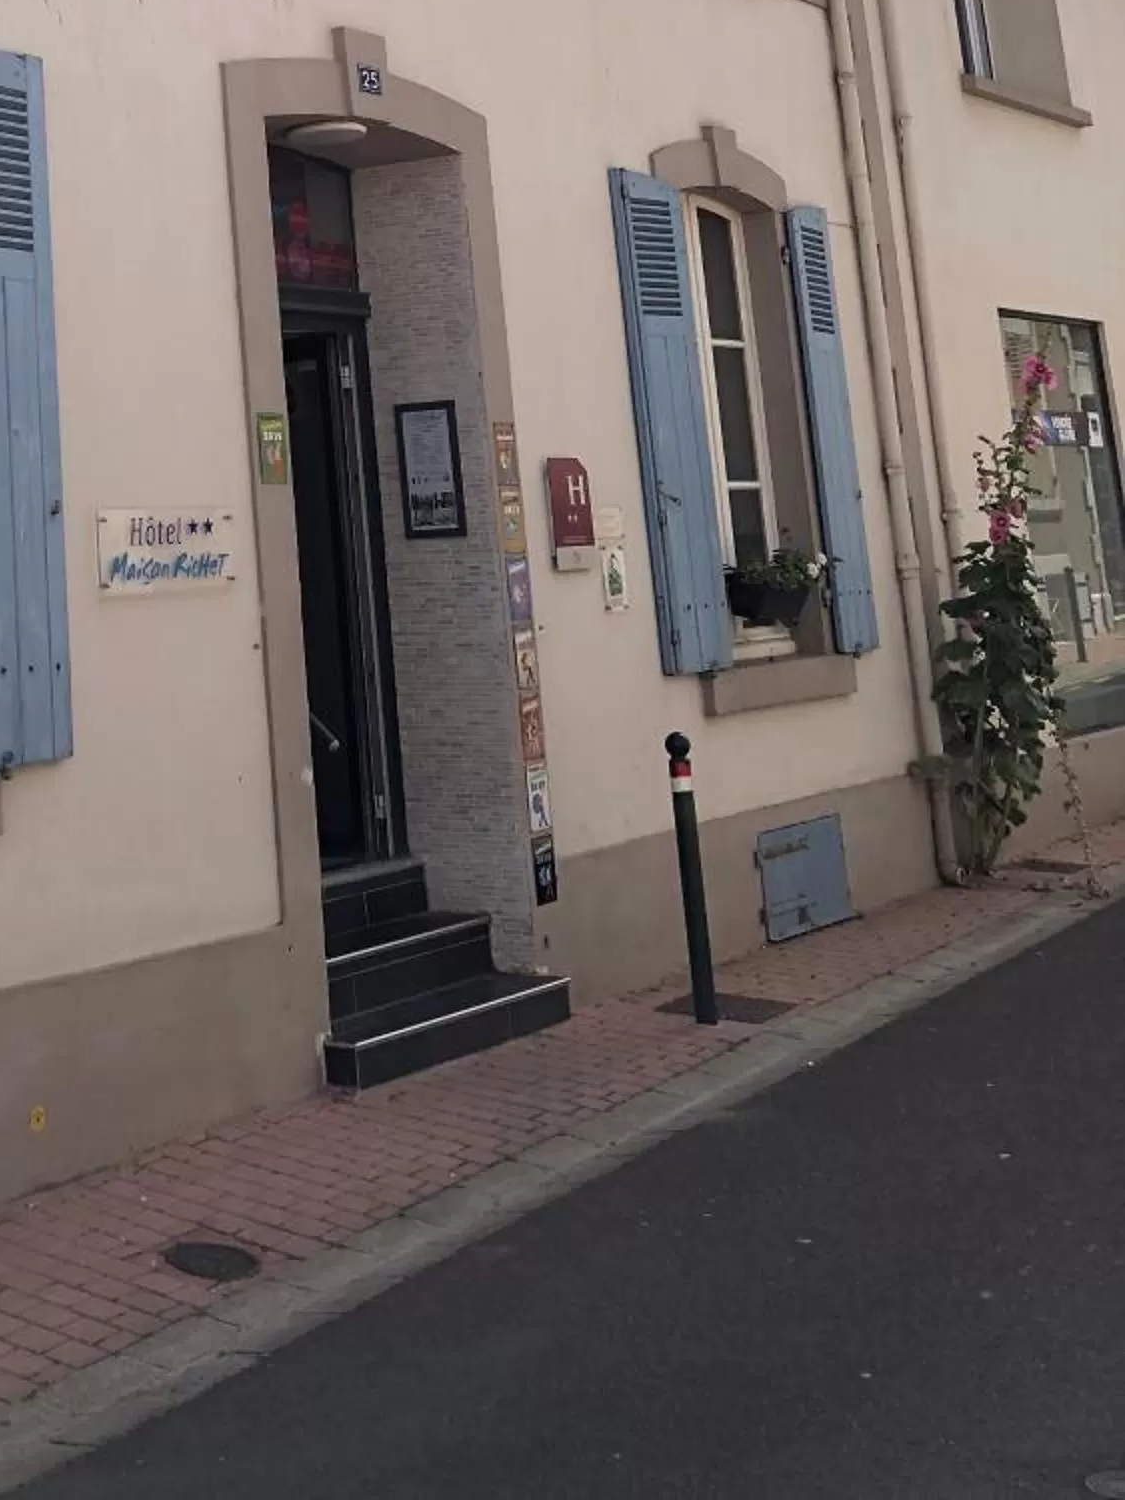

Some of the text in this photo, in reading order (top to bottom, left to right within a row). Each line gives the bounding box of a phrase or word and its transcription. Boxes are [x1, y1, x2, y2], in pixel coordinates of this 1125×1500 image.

[362, 70, 380, 90] 25
[566, 474, 586, 506] H
[129, 516, 182, 547] Hôtel
[110, 550, 170, 583] Maison
